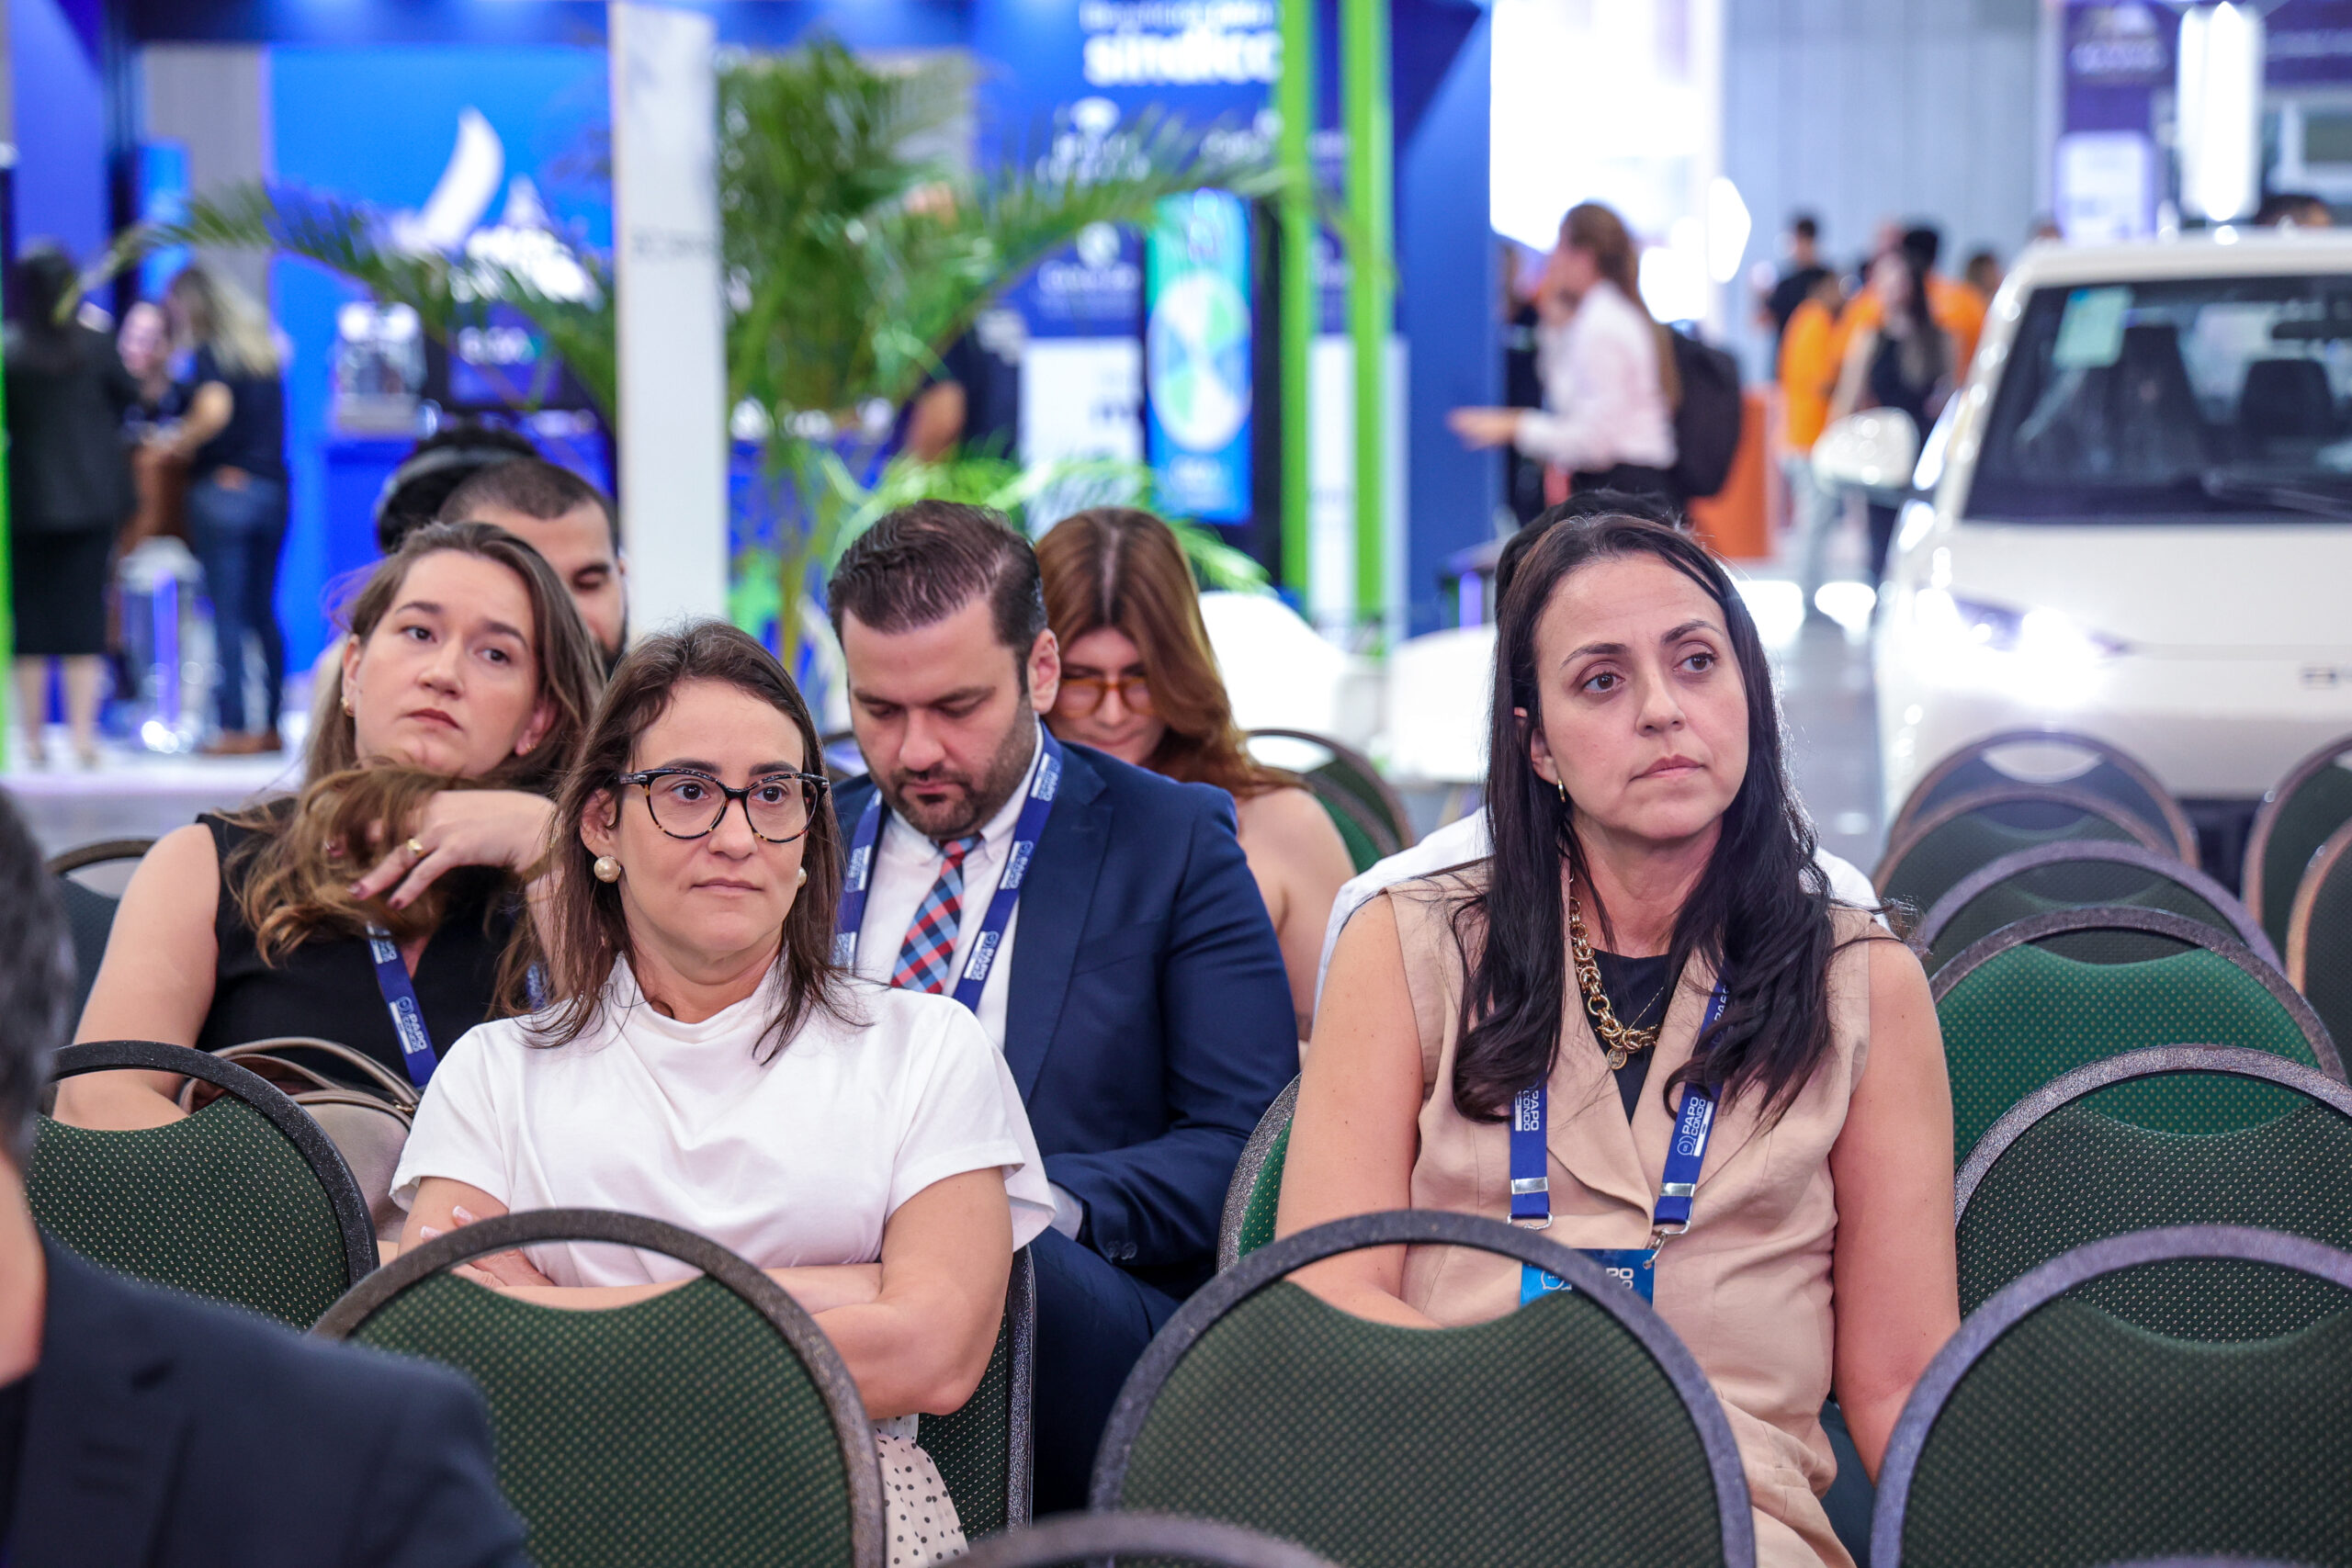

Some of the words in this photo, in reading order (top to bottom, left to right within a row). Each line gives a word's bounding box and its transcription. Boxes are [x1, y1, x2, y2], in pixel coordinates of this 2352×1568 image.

[408, 1013, 427, 1050] PAPO
[1531, 1090, 1540, 1131] PAPO
[1681, 1097, 1699, 1134] PAPO
[1690, 1099, 1706, 1136] CONDO
